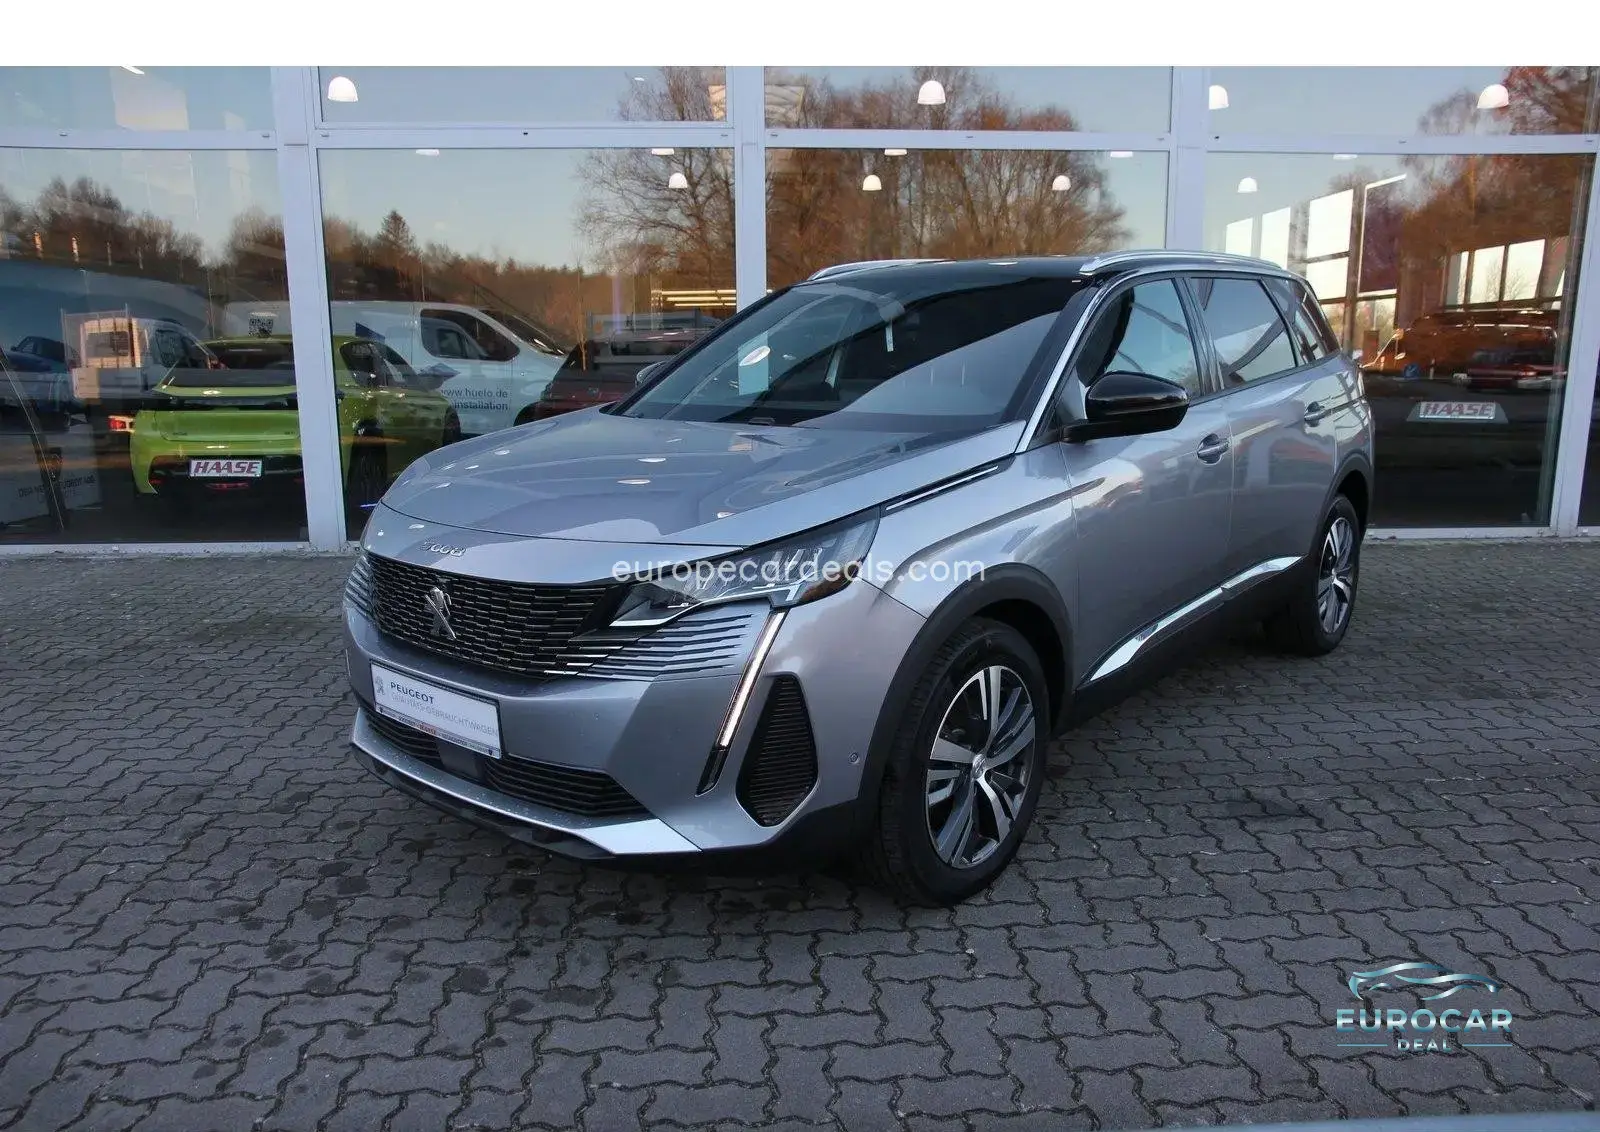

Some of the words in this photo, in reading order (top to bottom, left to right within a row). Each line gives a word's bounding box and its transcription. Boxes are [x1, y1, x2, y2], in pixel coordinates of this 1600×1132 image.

[1424, 403, 1493, 416] HAASE
[193, 461, 260, 474] HAASE
[390, 681, 434, 704] PEUGEOT
